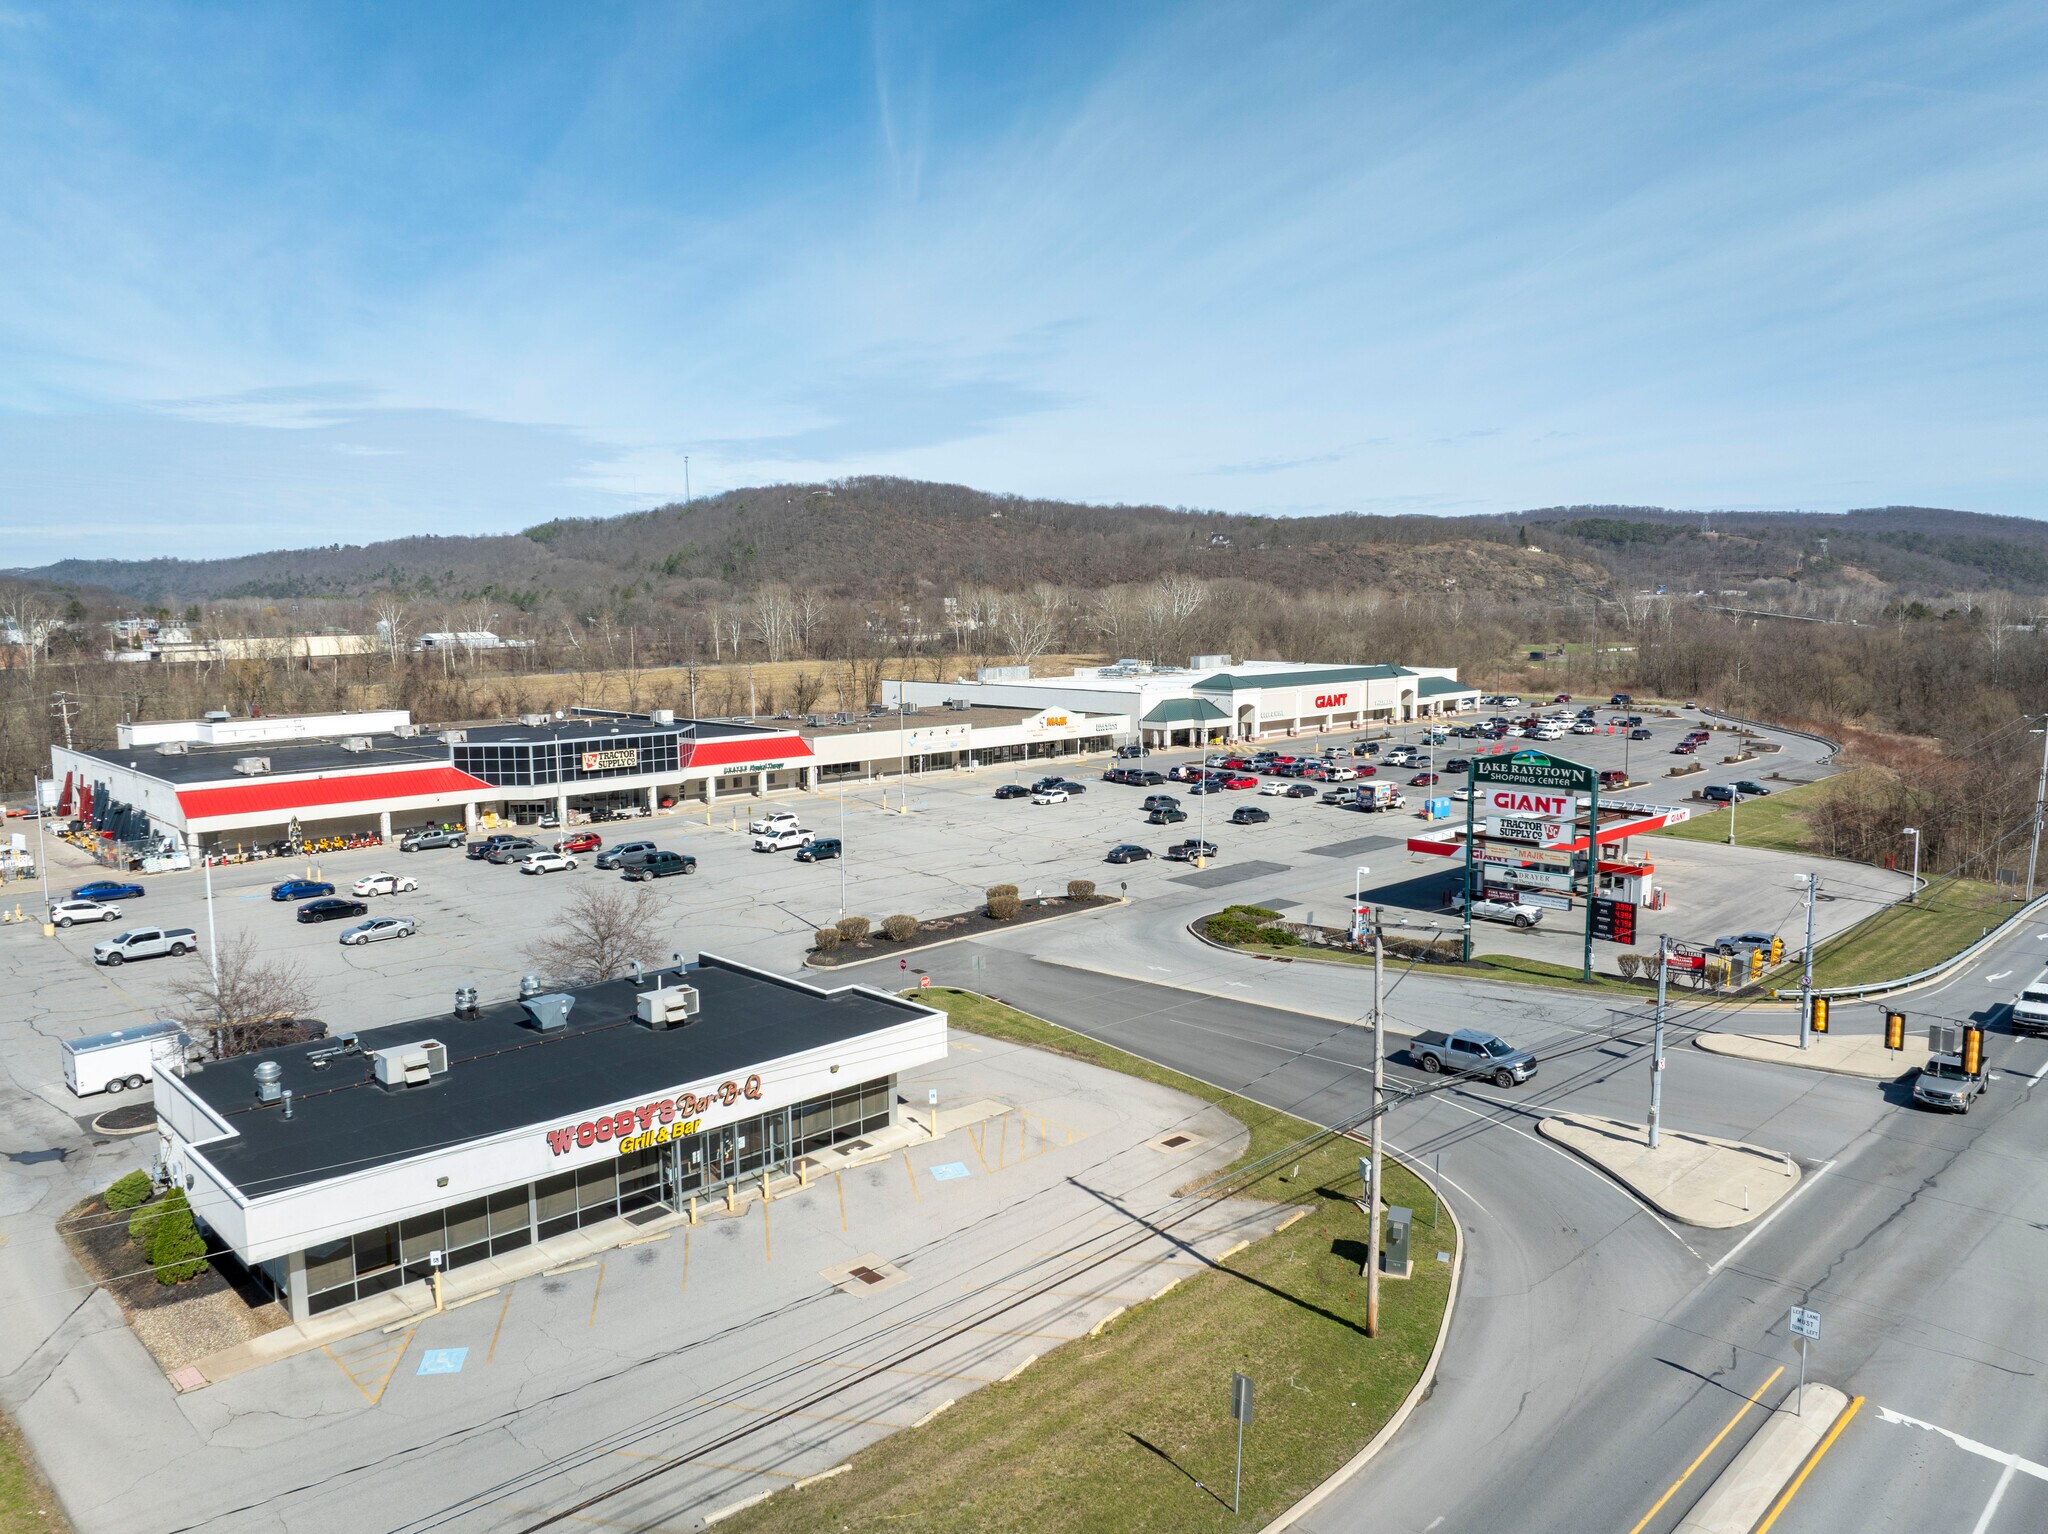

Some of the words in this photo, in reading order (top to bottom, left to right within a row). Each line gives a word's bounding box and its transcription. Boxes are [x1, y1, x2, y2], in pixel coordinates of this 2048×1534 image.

[1315, 693, 1348, 709] GIANT
[599, 750, 635, 760] TRACTOR
[599, 760, 626, 769] SUPPLY
[1478, 762, 1508, 774] LAKE
[1511, 764, 1586, 782] RAYSTOWN
[1490, 772, 1536, 784] SHOPPING
[1538, 777, 1570, 787] CENTER
[1493, 792, 1567, 815] GIANT
[1671, 811, 1686, 823] GIANT
[1500, 818, 1543, 831] TRACTOR
[1544, 823, 1559, 838] TSC
[1499, 827, 1532, 840] SUPPLY
[1518, 850, 1545, 860] MAJIK
[1519, 872, 1551, 882] DRAYER
[547, 1098, 676, 1156] WOODY'S
[619, 1132, 655, 1154] Grill
[656, 1126, 669, 1143] &
[671, 1118, 702, 1139] Bar
[1797, 1318, 1813, 1327] MUST
